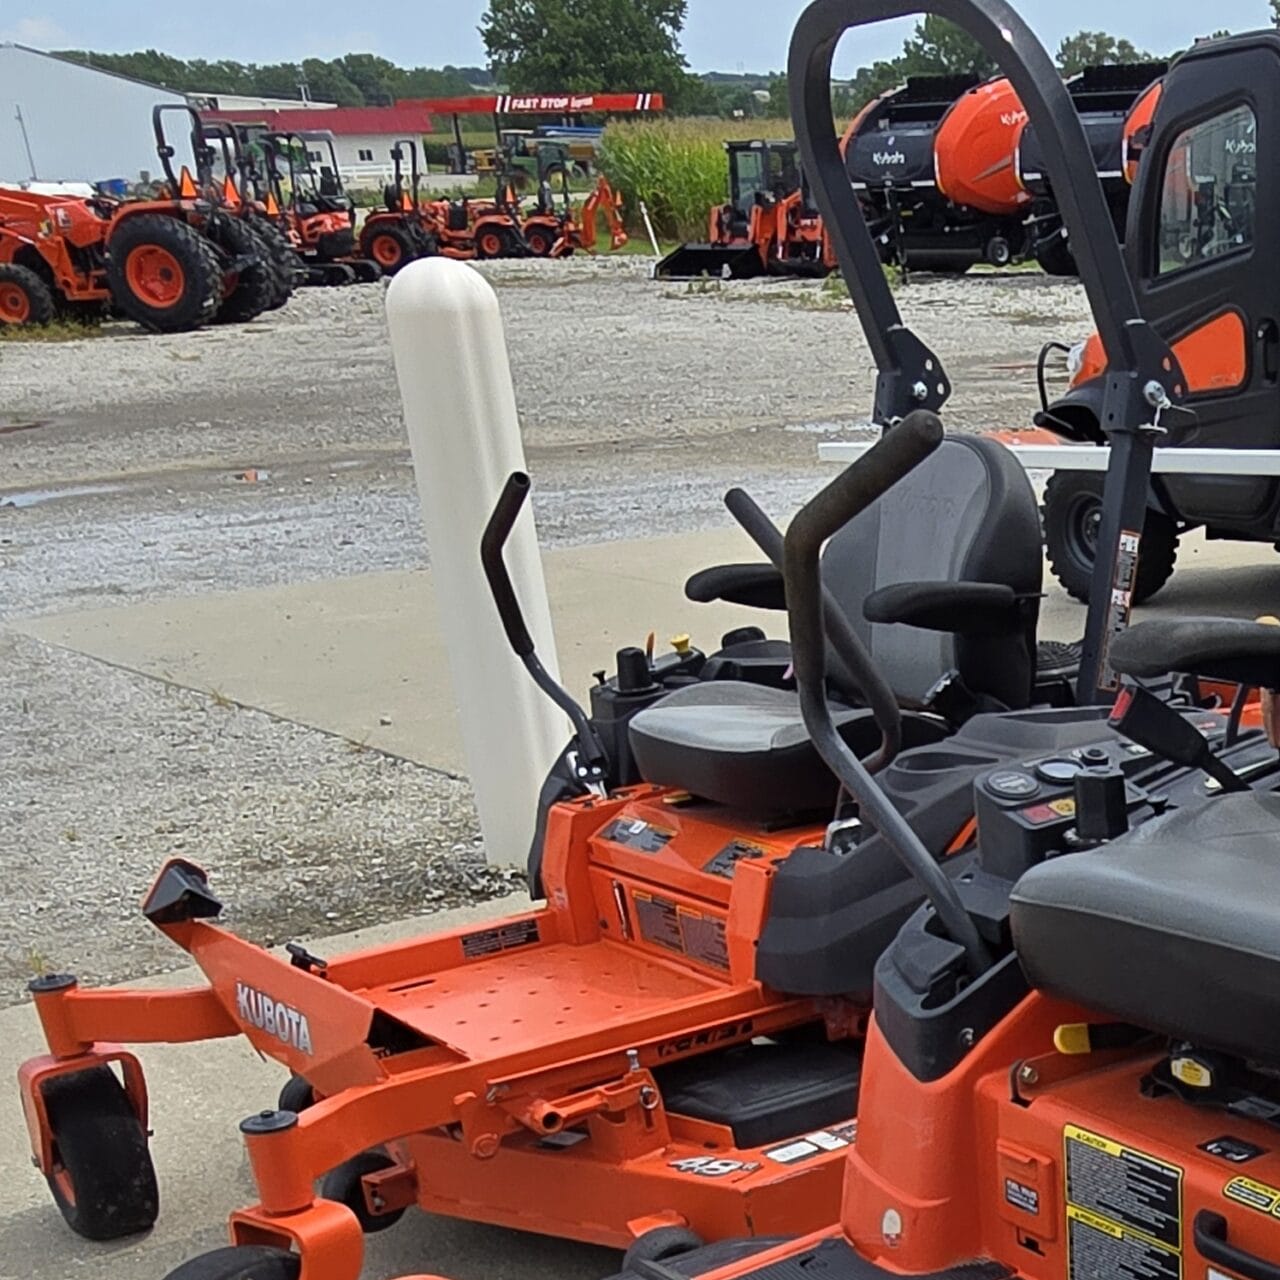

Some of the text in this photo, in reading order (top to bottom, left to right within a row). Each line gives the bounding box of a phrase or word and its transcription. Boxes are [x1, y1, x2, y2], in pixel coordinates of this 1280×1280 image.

[512, 98, 539, 110] FAST
[540, 97, 568, 109] STOP
[873, 151, 905, 165] Kubota
[236, 981, 314, 1057] KUBOTA
